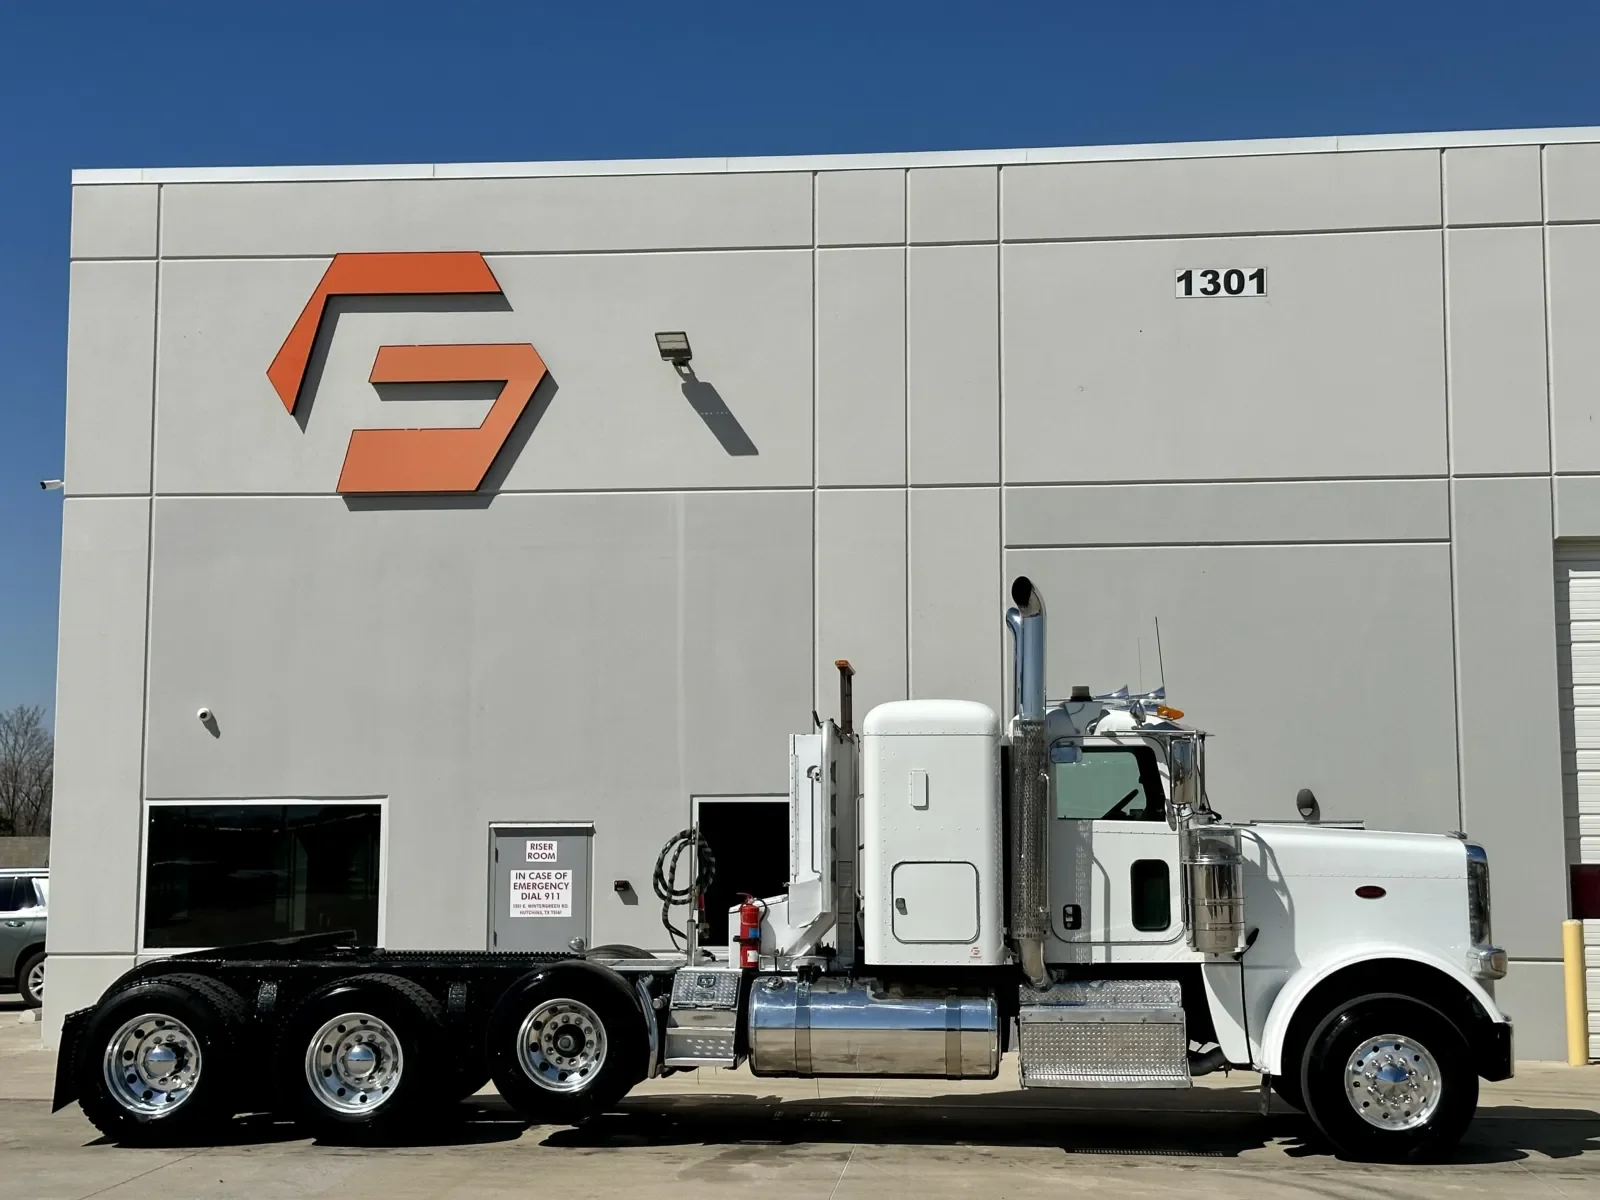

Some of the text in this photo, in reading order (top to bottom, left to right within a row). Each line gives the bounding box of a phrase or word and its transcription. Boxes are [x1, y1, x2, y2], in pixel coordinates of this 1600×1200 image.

[1177, 268, 1264, 296] 1301
[530, 843, 553, 851] RISER
[527, 852, 556, 860] ROOM
[515, 872, 568, 880] IN CASE OF
[513, 882, 570, 890] EMERGENCY
[520, 892, 560, 900] DIAL 911
